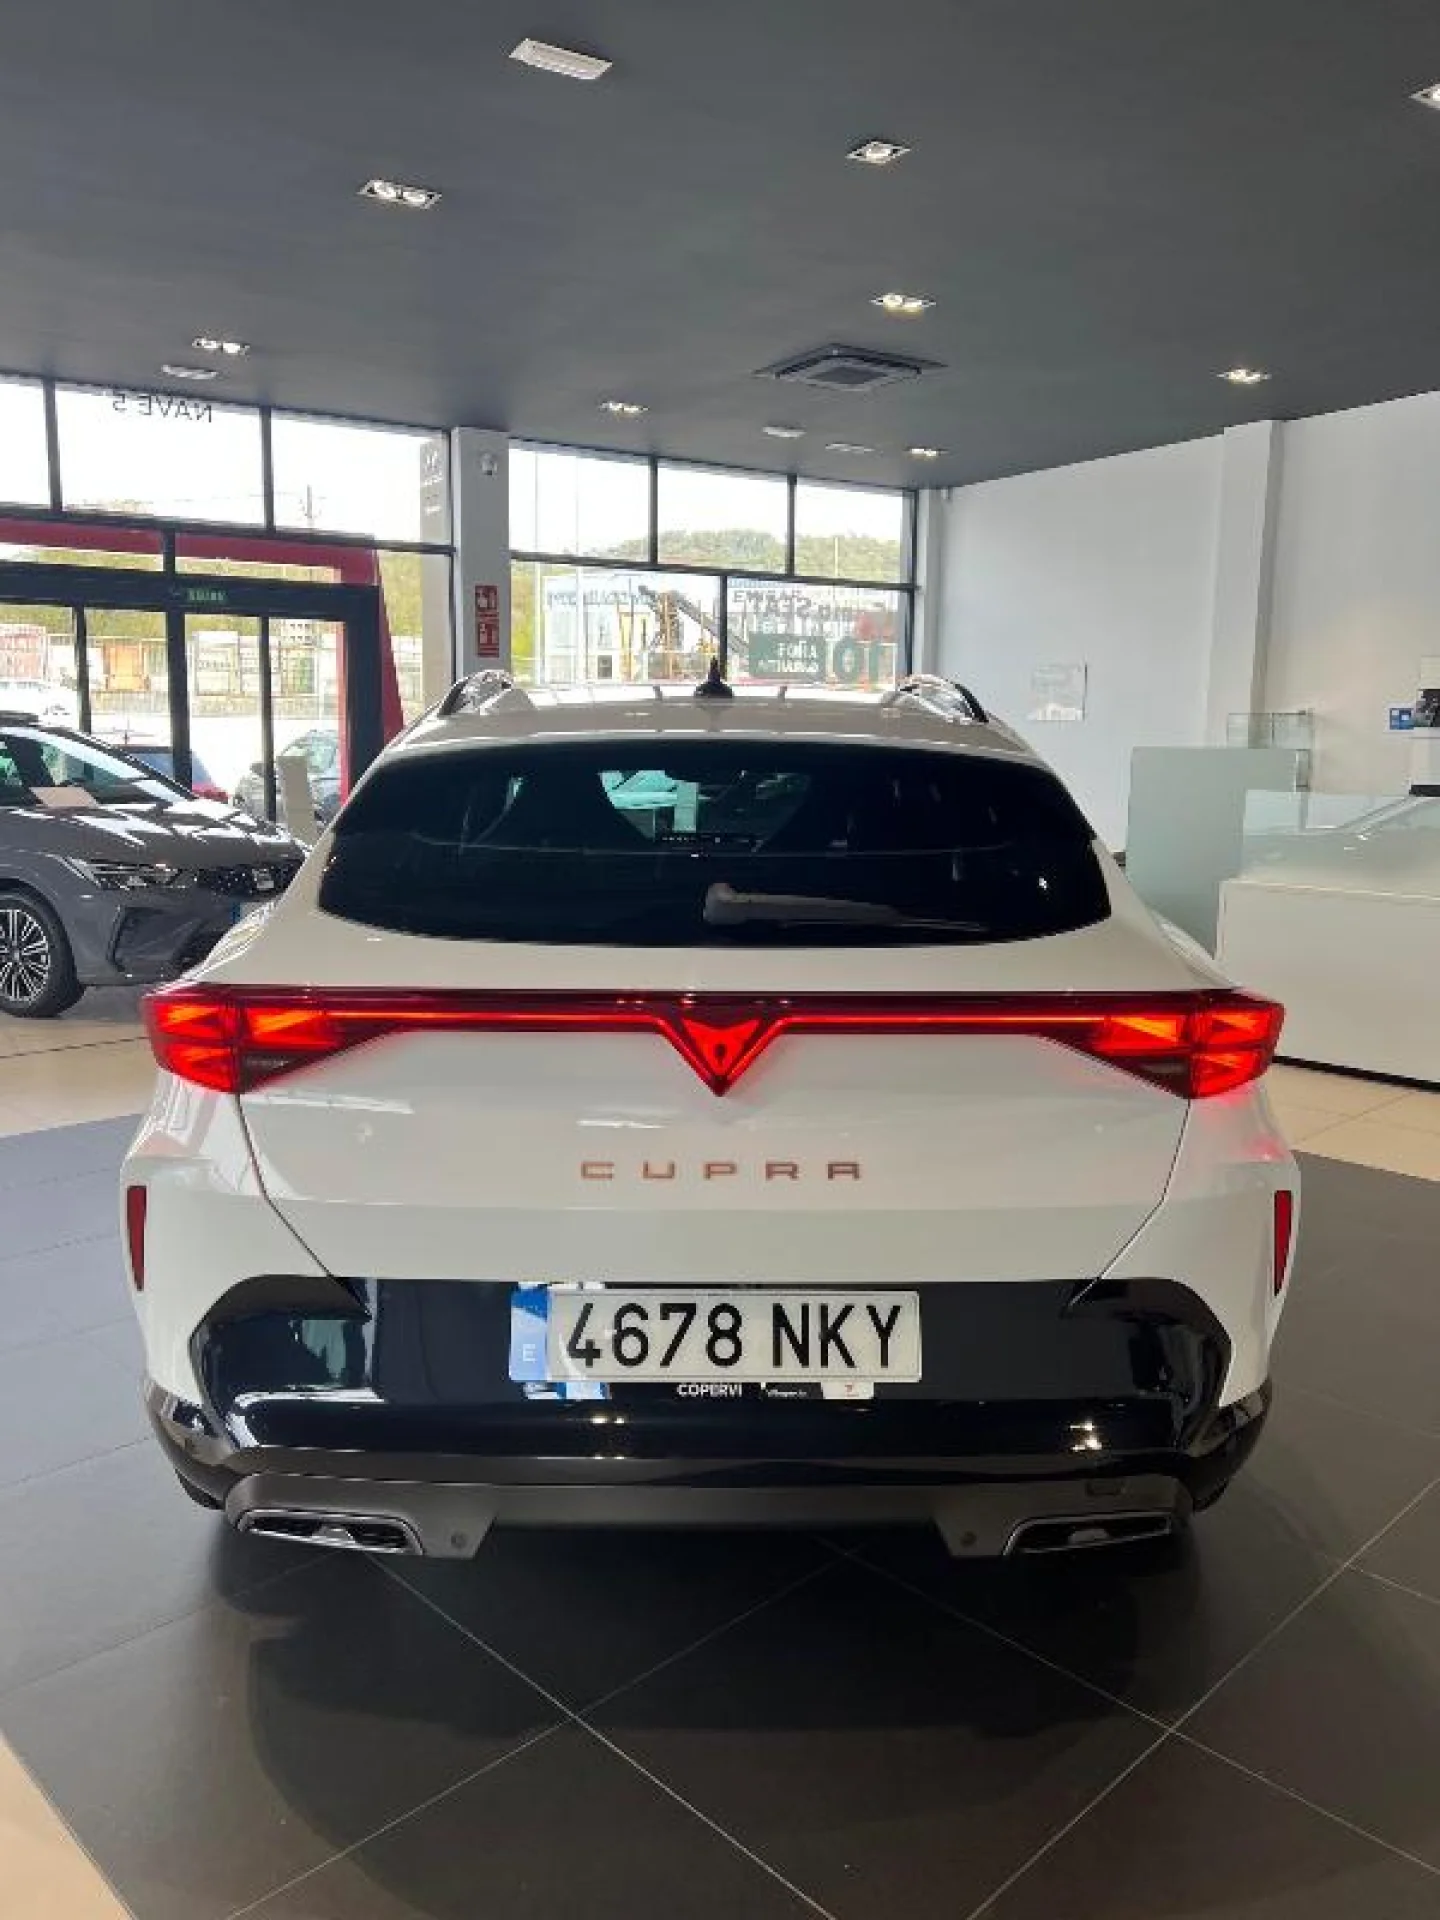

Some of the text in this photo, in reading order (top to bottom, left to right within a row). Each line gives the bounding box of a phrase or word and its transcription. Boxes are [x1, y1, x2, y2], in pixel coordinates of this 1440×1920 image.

[580, 1161, 861, 1181] CUPRA
[567, 1302, 901, 1368] 4678 NKY
[522, 1343, 537, 1362] E
